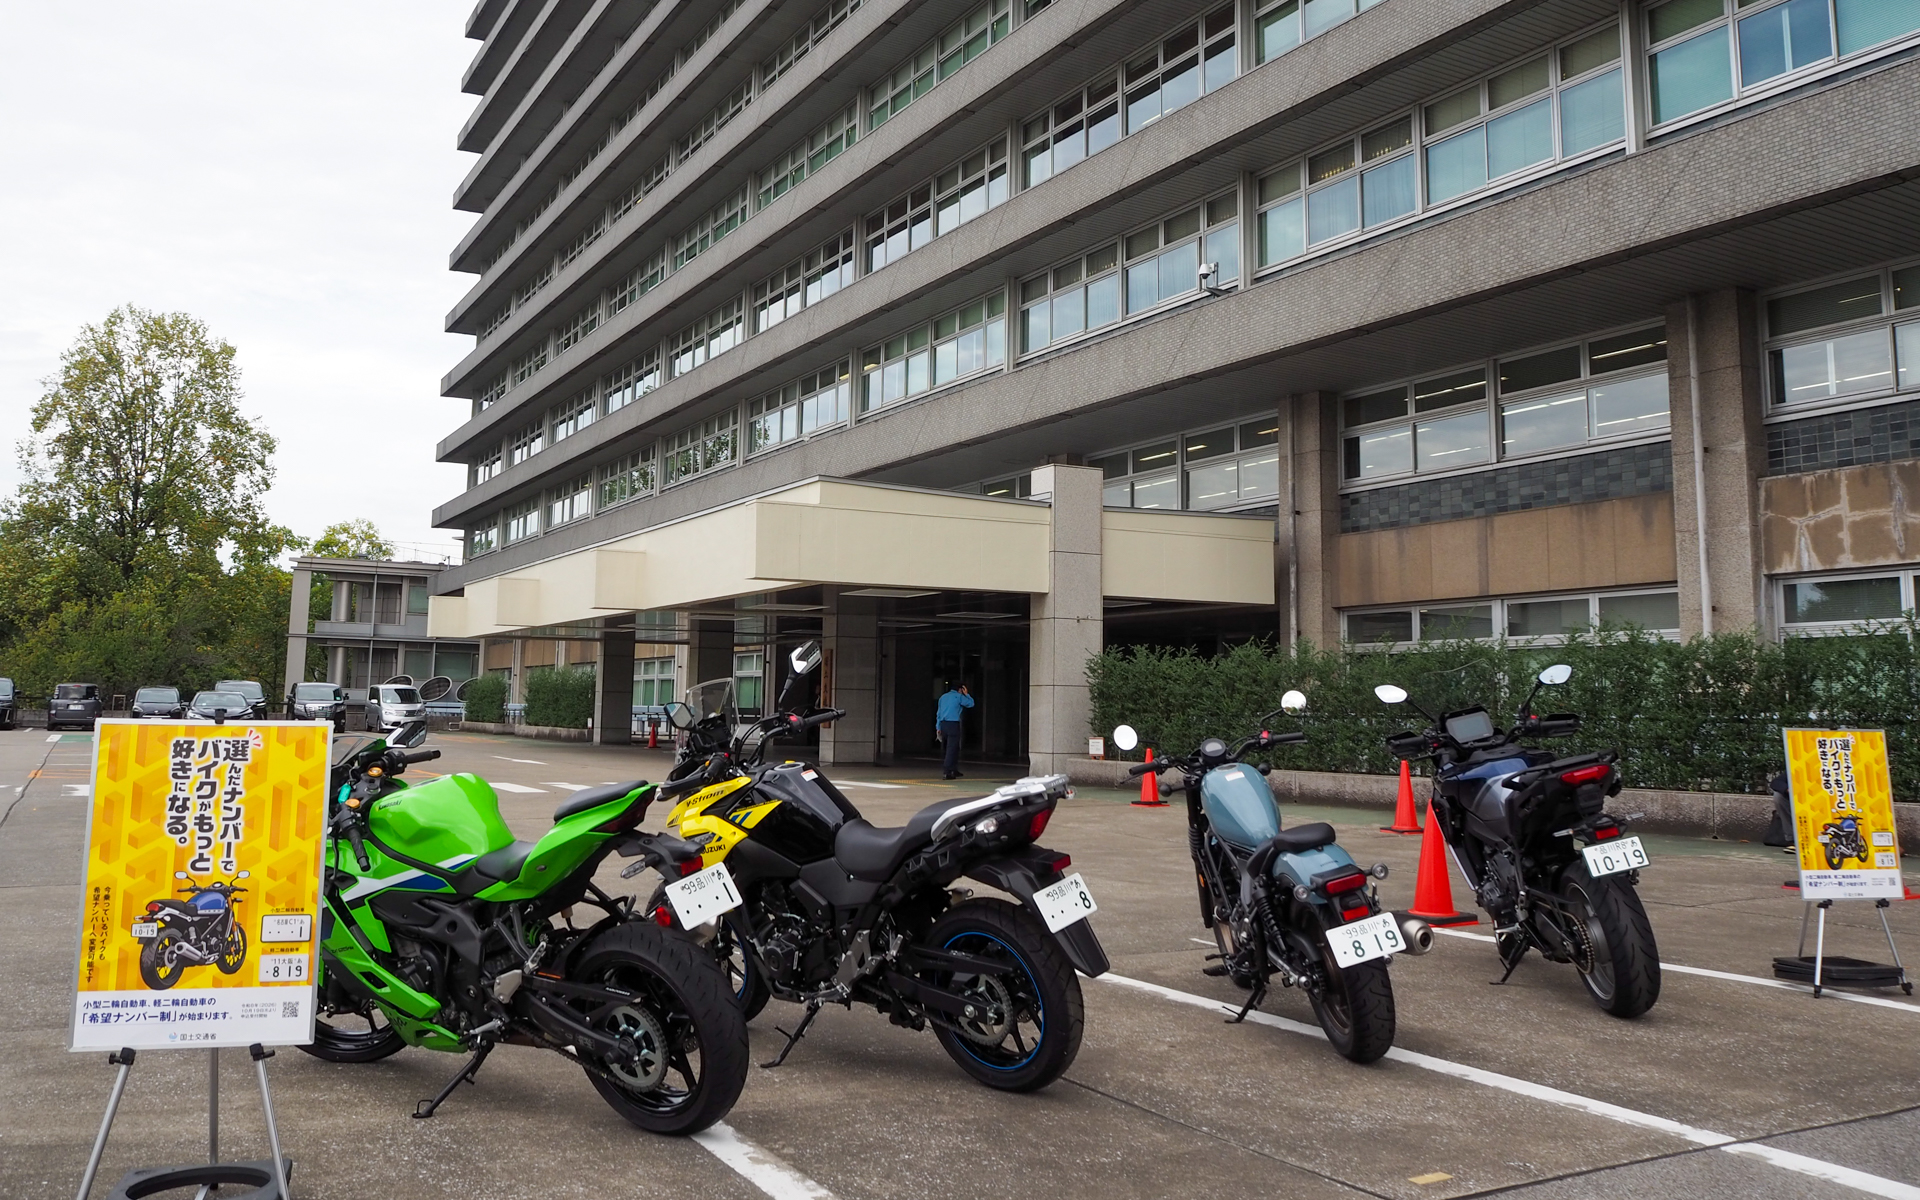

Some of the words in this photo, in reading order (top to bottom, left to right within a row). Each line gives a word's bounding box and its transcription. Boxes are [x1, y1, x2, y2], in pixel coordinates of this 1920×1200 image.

[167, 739, 195, 844] 好きになる。
[1817, 738, 1833, 795] 好きになる。
[1829, 738, 1846, 809] バイクがもっと
[1839, 738, 1856, 809] 選んだナンバーで
[190, 739, 221, 872] バイクがもっと
[220, 739, 249, 871] 選んだナンバーで
[1593, 849, 1645, 874] 10-19
[99, 886, 111, 960] 今乗っているバイクも
[82, 1010, 233, 1024] 「希望ナンバー制」が始まります。
[83, 997, 216, 1009] 小型二輪自動車、軽二輪自動車の
[180, 1032, 217, 1042] 国土交通省
